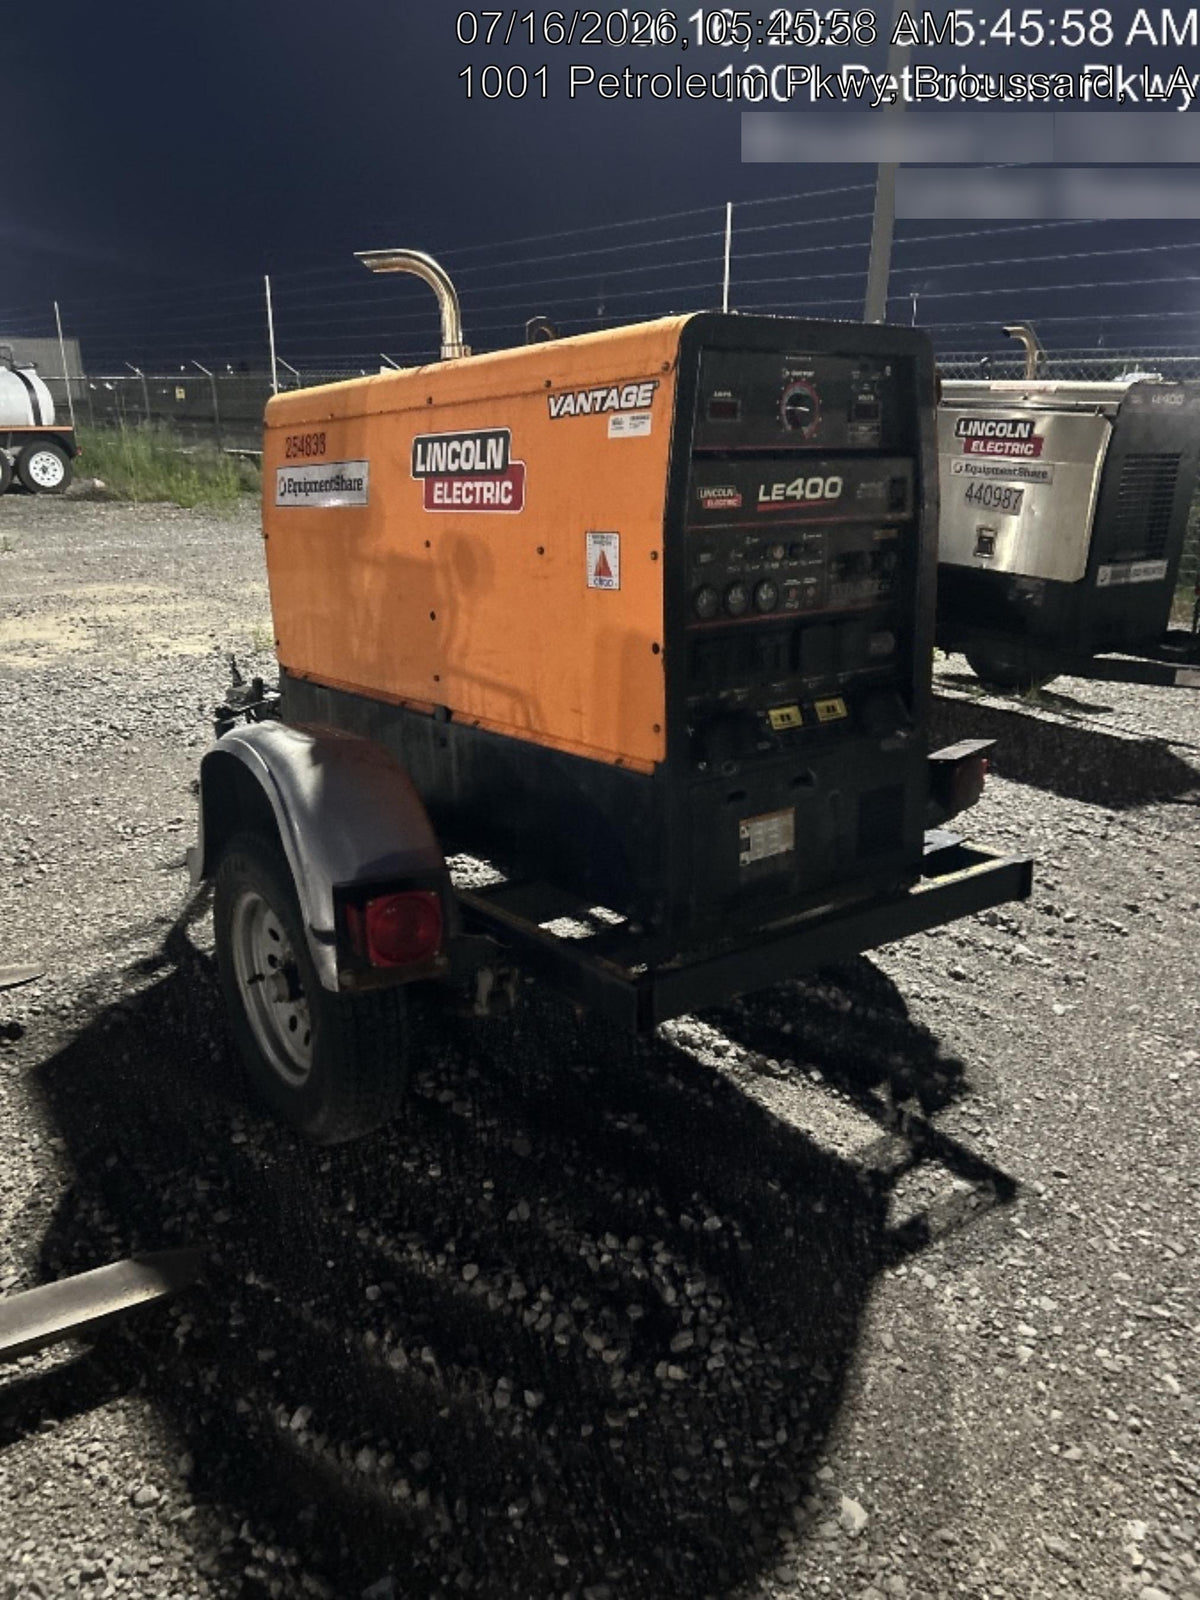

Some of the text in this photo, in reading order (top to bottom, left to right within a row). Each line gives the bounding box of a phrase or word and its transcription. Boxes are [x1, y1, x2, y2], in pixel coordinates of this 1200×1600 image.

[549, 383, 655, 417] VANTAGE
[958, 420, 1031, 438] LINCOLN
[415, 437, 504, 472] LINCOLN
[971, 440, 1035, 455] ELECTRIC
[964, 463, 1049, 479] EquipmentShare
[287, 475, 364, 496] EquipmentShare
[433, 481, 513, 505] ELECTRIC
[758, 475, 844, 502] LE400
[965, 482, 1025, 510] 440987
